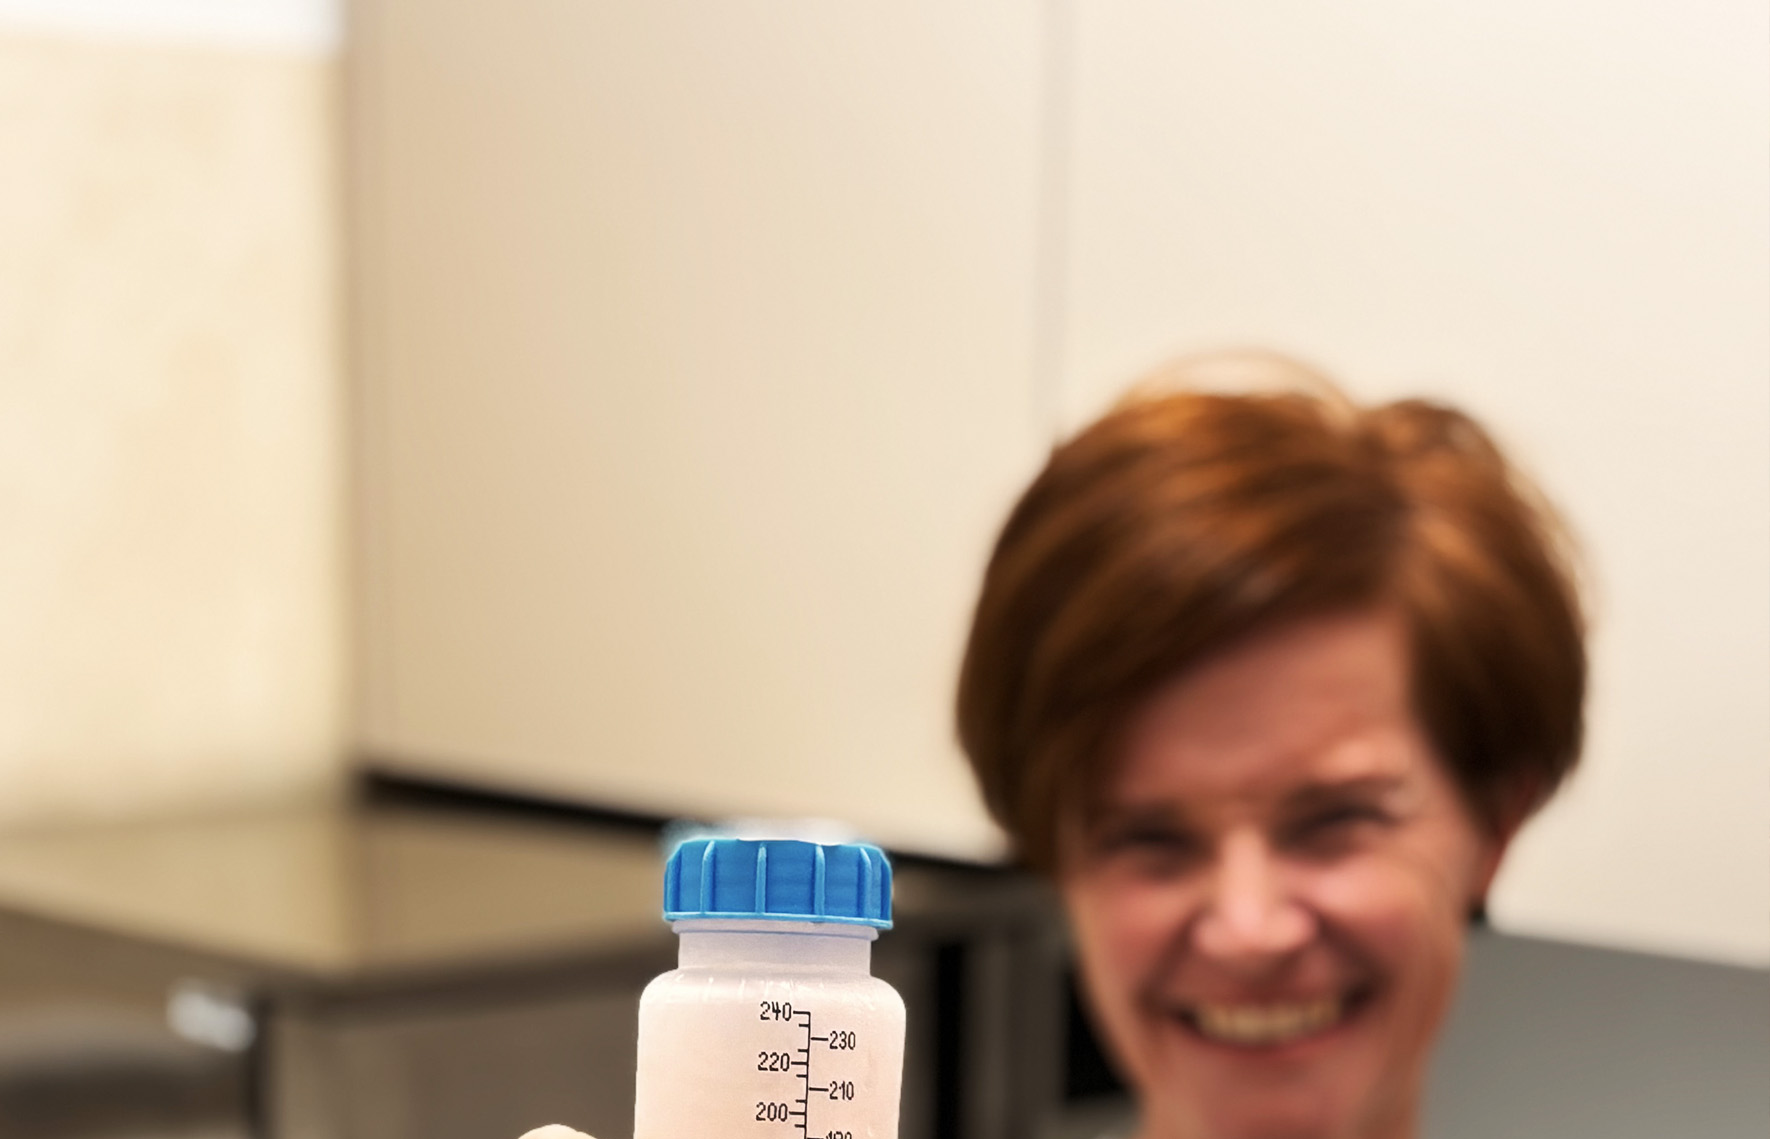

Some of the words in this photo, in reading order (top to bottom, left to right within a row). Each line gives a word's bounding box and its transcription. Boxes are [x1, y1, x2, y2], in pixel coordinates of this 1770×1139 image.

[760, 1001, 792, 1021] 240
[829, 1031, 856, 1050] 230
[758, 1052, 790, 1071] 220
[829, 1081, 854, 1100] 210
[756, 1102, 788, 1122] 200
